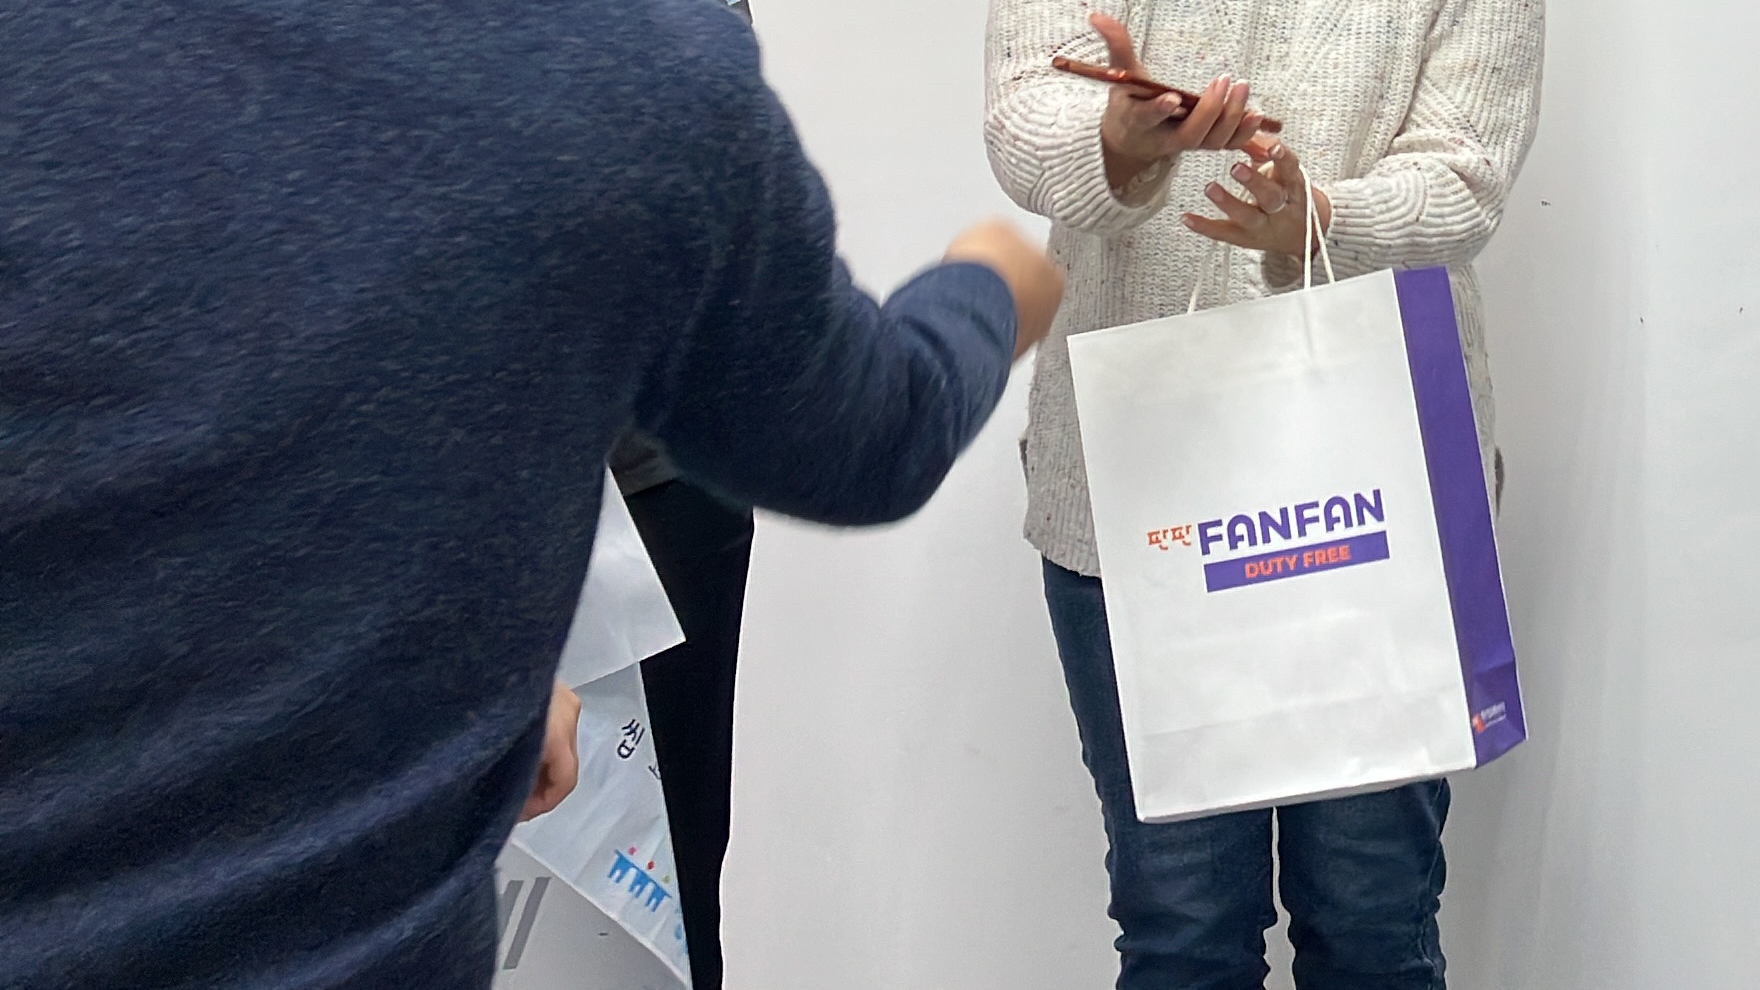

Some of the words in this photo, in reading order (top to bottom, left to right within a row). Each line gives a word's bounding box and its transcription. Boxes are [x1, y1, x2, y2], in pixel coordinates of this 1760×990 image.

[1198, 489, 1384, 555] FANFAN
[1245, 555, 1298, 578] DUTY
[1303, 545, 1351, 568] FREE
